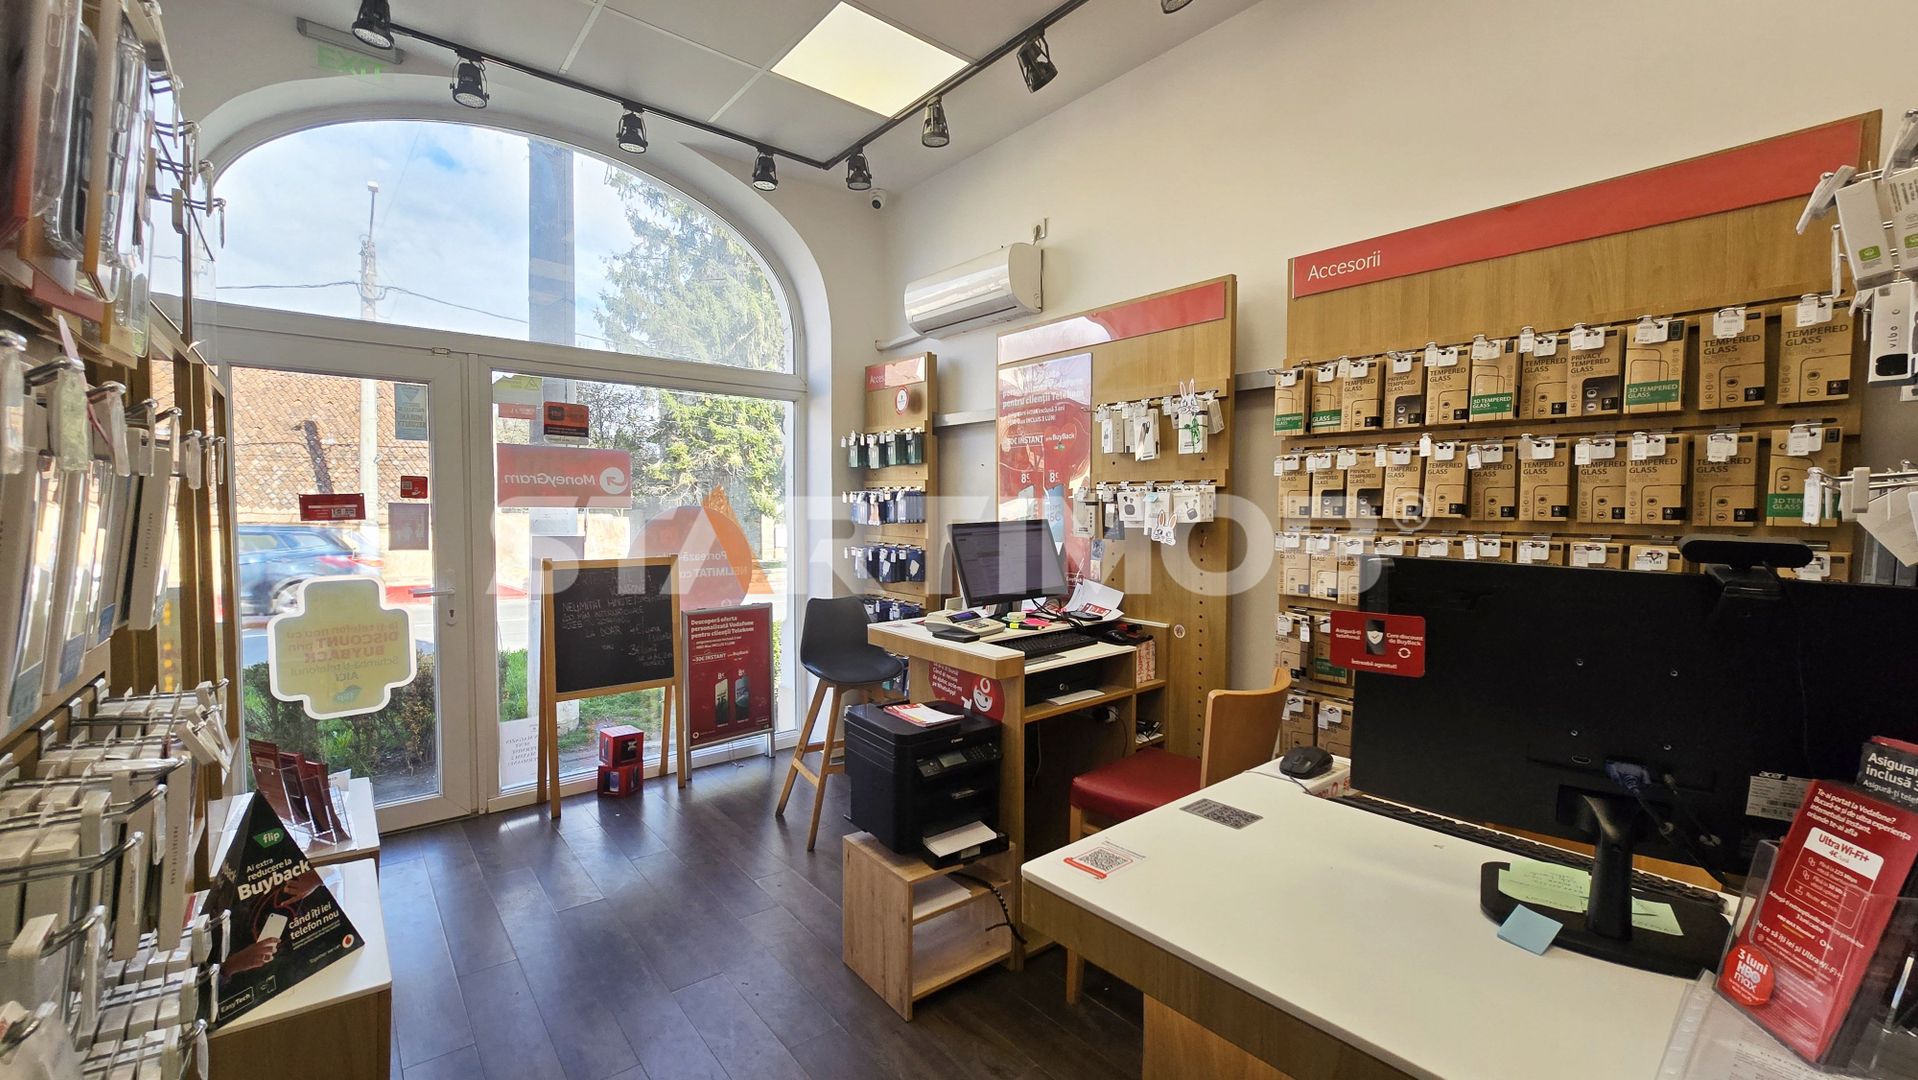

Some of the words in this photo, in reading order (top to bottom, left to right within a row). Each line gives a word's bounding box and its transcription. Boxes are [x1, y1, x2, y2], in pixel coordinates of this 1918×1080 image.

[1307, 250, 1381, 281] Accesorii
[1786, 325, 1849, 338] TEMPERED
[1704, 334, 1761, 348] TEMPERED
[1785, 336, 1822, 347] GLASS
[1704, 345, 1738, 356] GLASS
[1571, 352, 1602, 361] PRIVACY
[1524, 357, 1567, 367] TEMPERED
[1571, 358, 1610, 367] TEMPERED
[1430, 367, 1466, 376] TEMPERED
[1524, 366, 1549, 374] GLASS
[1570, 366, 1594, 374] GLASS
[1344, 378, 1376, 387] TEMPERED
[1639, 383, 1678, 393] TEMPERED
[1481, 396, 1512, 404] TEMPERED
[1428, 462, 1463, 470] TEMPERED
[1523, 460, 1565, 469] TEMPERED
[1629, 457, 1678, 466] TEMPERED
[1477, 463, 1513, 472] EMPERED
[1581, 468, 1608, 476] GLASS
[1629, 466, 1658, 474] GLASS
[1697, 466, 1729, 474] GLASS
[1473, 470, 1497, 478] GLASS
[1759, 770, 1785, 780] acer
[1866, 764, 1912, 789] inclusă
[262, 831, 281, 844] flip
[1818, 833, 1841, 851] Ultra
[1841, 842, 1870, 863] Wi-Fi+
[256, 857, 274, 870] extra
[247, 862, 285, 882] reducere
[285, 858, 292, 867] la
[237, 860, 311, 901] Buyback
[289, 912, 311, 930] când
[290, 917, 323, 940] telefon
[323, 910, 340, 926] nou
[1801, 947, 1820, 964] Ultra
[1737, 948, 1745, 960] 3
[1745, 953, 1769, 976] luni
[1736, 961, 1761, 984] HBO
[1733, 971, 1757, 993] max
[220, 992, 252, 1013] EasyTech
